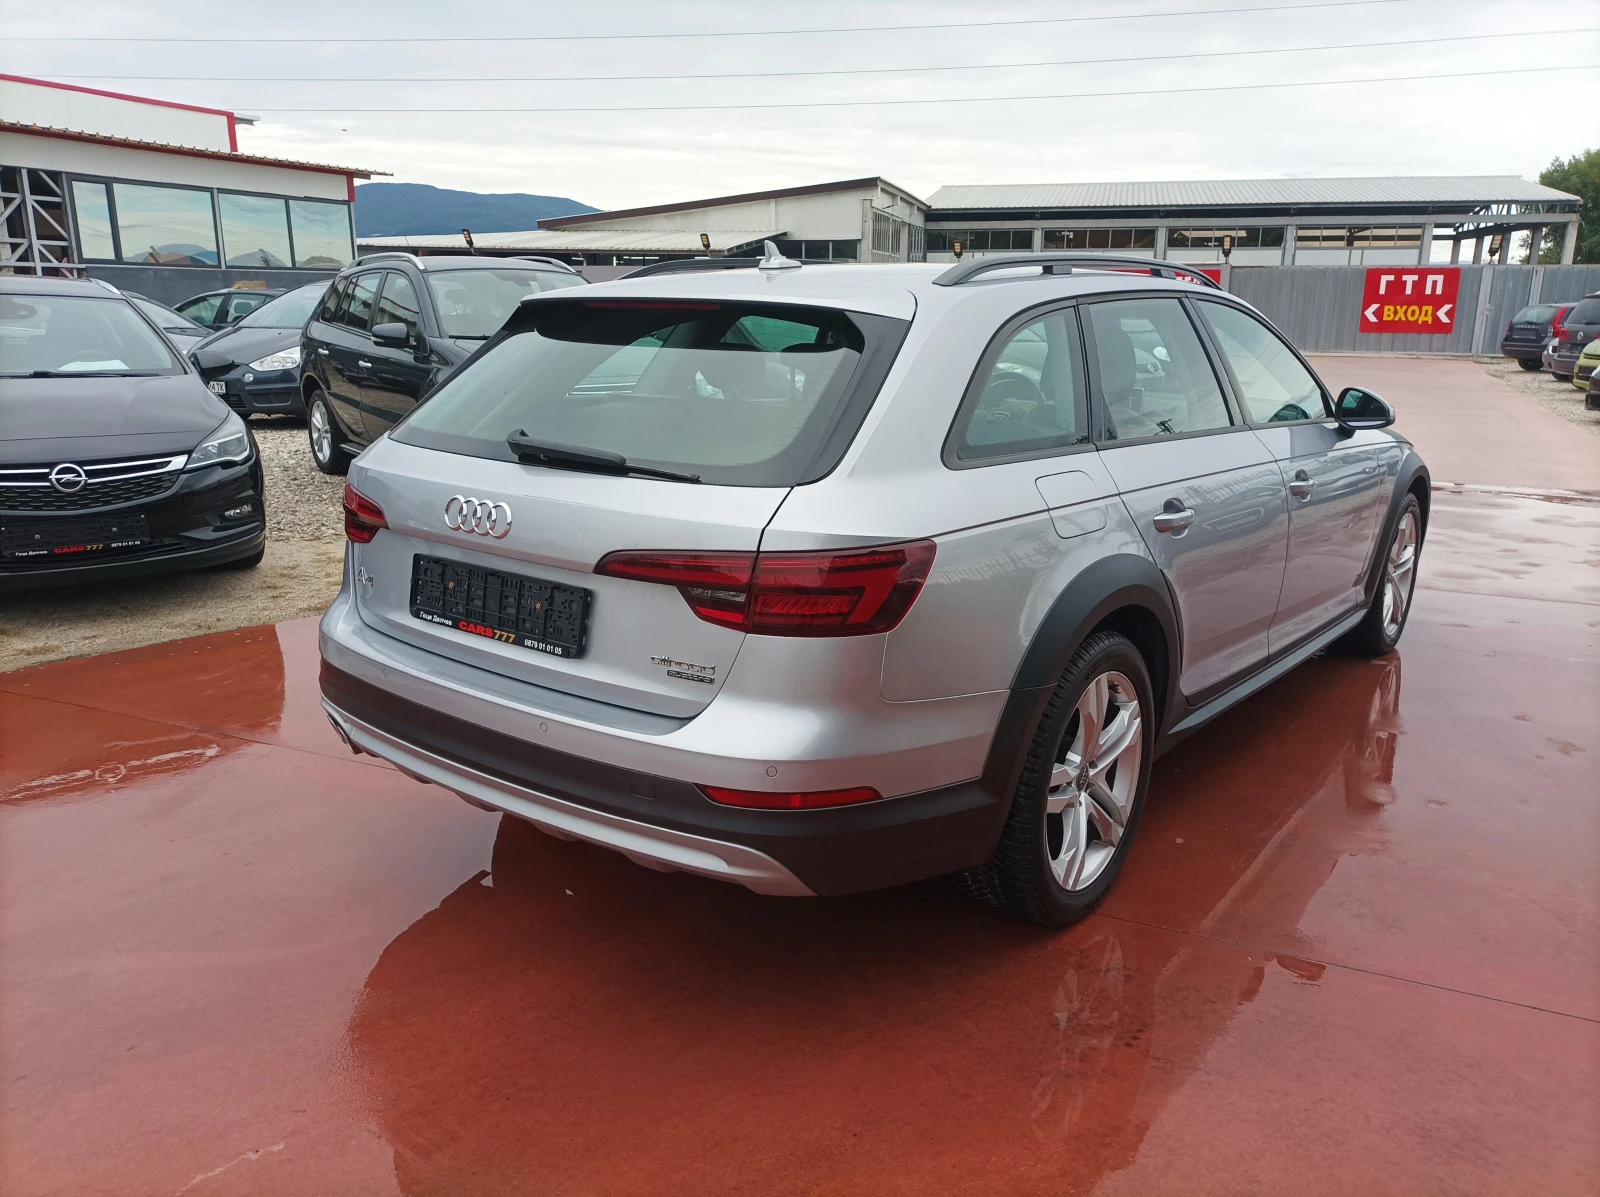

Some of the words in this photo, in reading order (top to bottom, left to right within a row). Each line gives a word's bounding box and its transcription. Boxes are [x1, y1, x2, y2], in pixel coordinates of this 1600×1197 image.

[1382, 304, 1434, 325] ВХОД
[420, 611, 433, 621] Гоце
[458, 620, 516, 644] CARS777
[524, 638, 538, 649] 0879
[538, 642, 546, 651] 01
[546, 644, 554, 653] 01
[554, 646, 563, 655] 05
[650, 655, 716, 675] allroad
